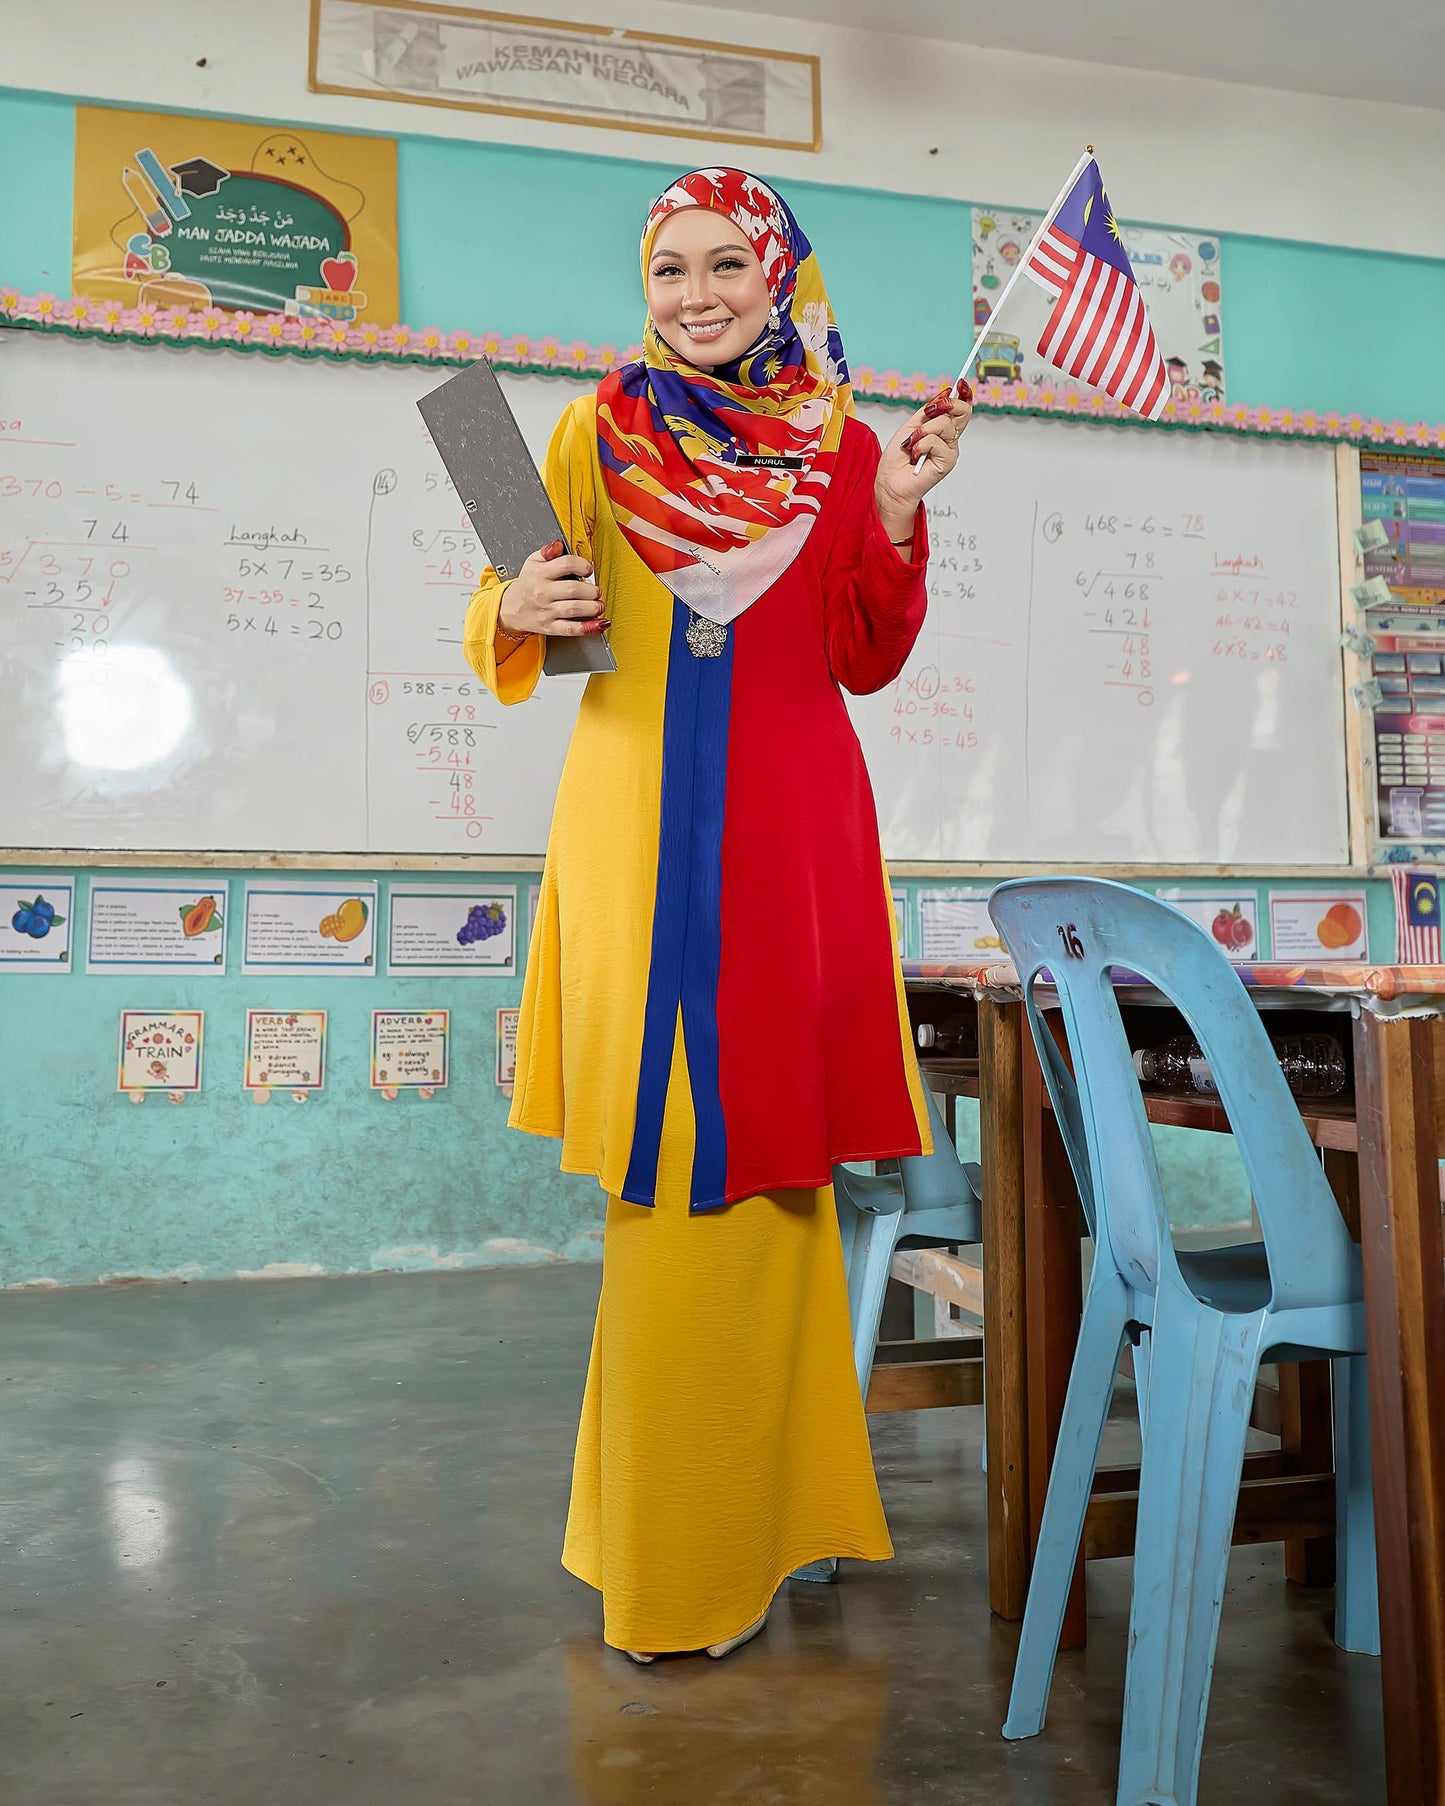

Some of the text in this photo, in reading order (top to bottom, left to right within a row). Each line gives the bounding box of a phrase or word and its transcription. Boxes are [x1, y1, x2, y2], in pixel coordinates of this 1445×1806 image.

[495, 45, 654, 78] KEMAHIRAN
[456, 57, 691, 110] WAWASAN NEGARA
[178, 226, 330, 251] MAN JADDA WAJADA
[754, 458, 786, 466] NURUL
[160, 479, 200, 505] 74
[1085, 514, 1118, 536] 468
[230, 524, 308, 551] Langkah
[957, 532, 977, 551] 48
[1126, 552, 1155, 570] 78
[318, 564, 352, 584] 35
[957, 582, 977, 600] 36
[1104, 581, 1149, 601] 468
[70, 613, 110, 634] 20
[307, 620, 344, 641] 20
[403, 682, 436, 695] 588
[953, 676, 976, 694] 36
[447, 705, 476, 722] 98
[430, 728, 476, 747] 588
[955, 730, 979, 751] 45
[450, 771, 473, 792] 48
[255, 1016, 284, 1026] VERB
[379, 1016, 422, 1026] ADVERB
[504, 1015, 519, 1023] NO
[127, 1021, 185, 1042] GRAMMAR
[135, 1046, 184, 1059] TRAIN
